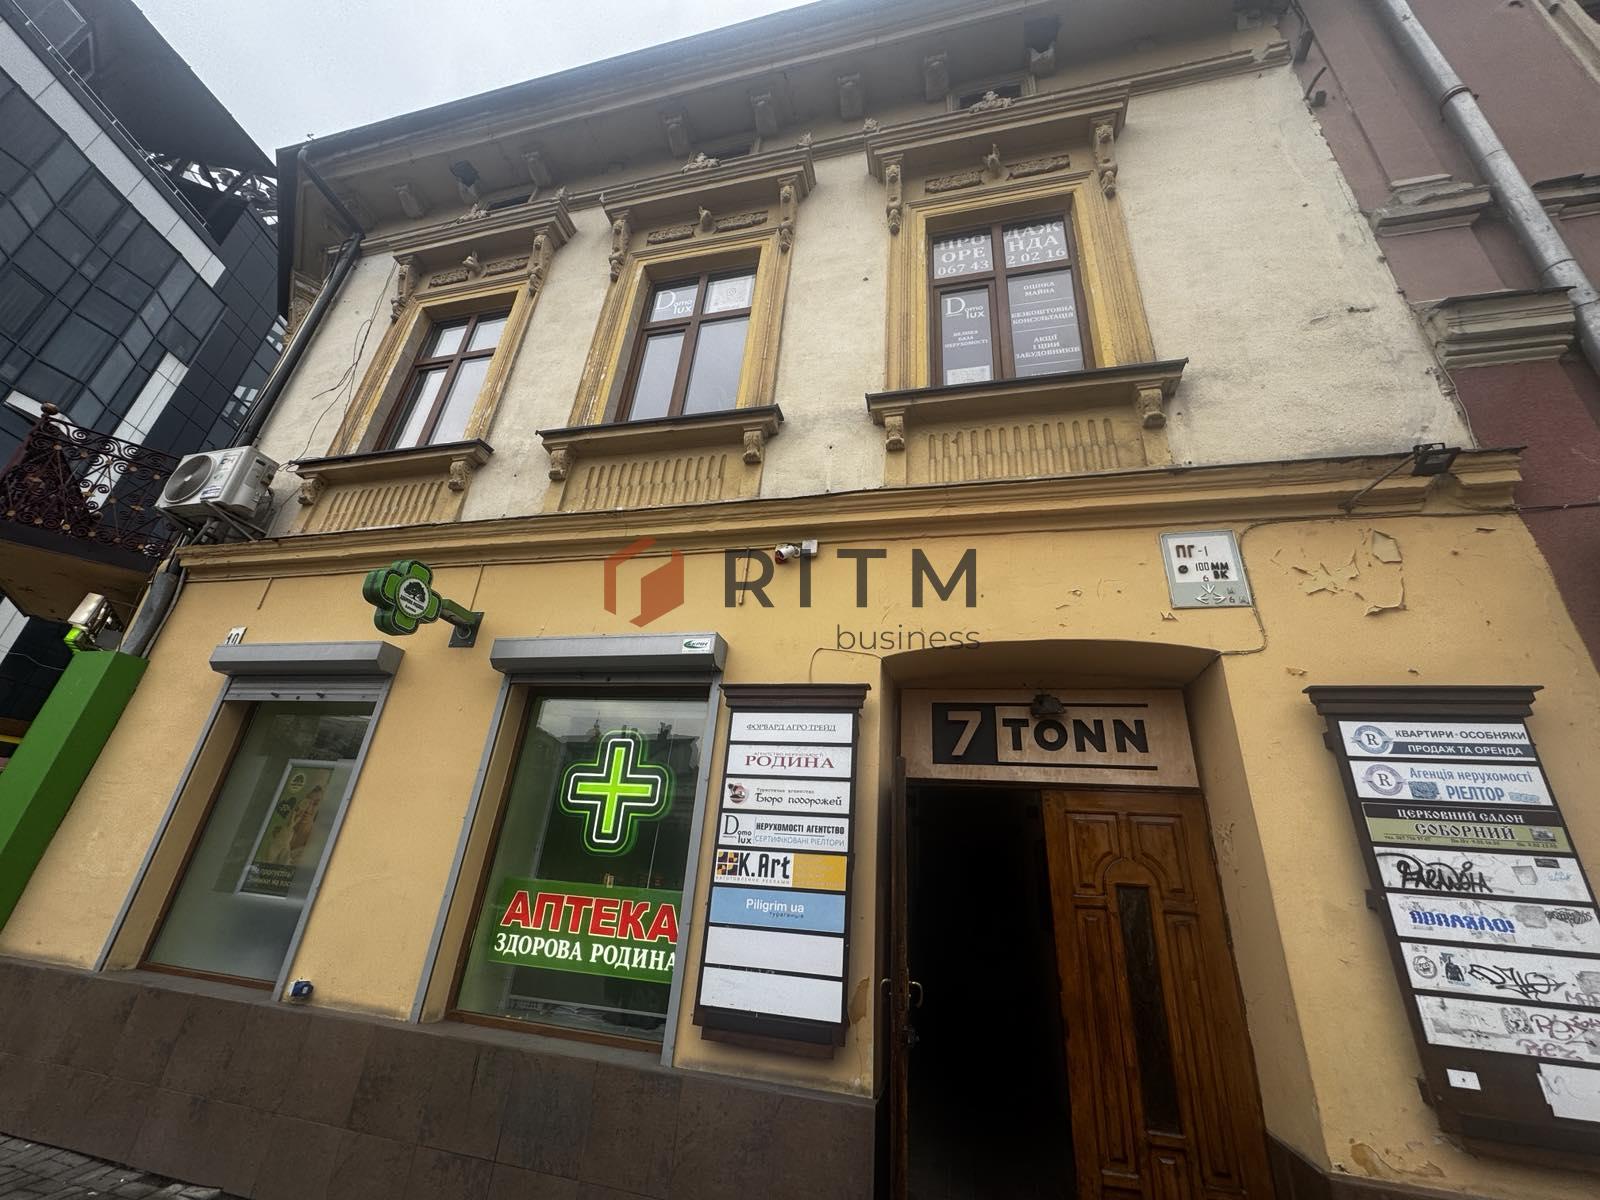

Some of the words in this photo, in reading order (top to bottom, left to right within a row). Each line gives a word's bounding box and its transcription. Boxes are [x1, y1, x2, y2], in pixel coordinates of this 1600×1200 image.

[938, 264, 966, 276] 067
[1020, 252, 1040, 262] 02
[1046, 248, 1065, 258] 16
[746, 723, 785, 731] ФОРВАРД
[808, 724, 837, 732] ТРЕЙД
[947, 710, 982, 757] 7
[1002, 718, 1149, 753] TONN
[1365, 733, 1379, 746] R
[1408, 744, 1455, 754] ПРОДАЖ
[1457, 746, 1471, 754] ТА
[1474, 746, 1523, 756] ОРЕНДА
[745, 755, 835, 769] РОДИНА
[1377, 774, 1392, 786] R
[1410, 767, 1454, 780] Агенція
[1457, 771, 1533, 784] нерухомості
[754, 792, 783, 806] Бюро
[788, 796, 842, 808] подорожей
[1445, 785, 1505, 801] РІЕЛТОР
[1397, 808, 1477, 822] ЦЕРКОВНИЙ
[1479, 811, 1524, 824] САЛОН
[756, 822, 804, 833] НЕРУХОМОСТІ
[806, 825, 845, 835] АГЕНТСТВО
[1415, 822, 1516, 840] СОБОРНИЙ
[738, 835, 752, 844] lux
[755, 835, 809, 845] СЕРТИФІКОВАНІ
[811, 838, 845, 847] РІЕЛТОРИ
[738, 852, 790, 879] K.Art
[746, 898, 787, 912] Piligrim
[790, 904, 805, 913] ua
[500, 890, 678, 944] АПТЕКА
[494, 932, 583, 961] ЗДОРОВА
[589, 943, 676, 972] РОДИНА
